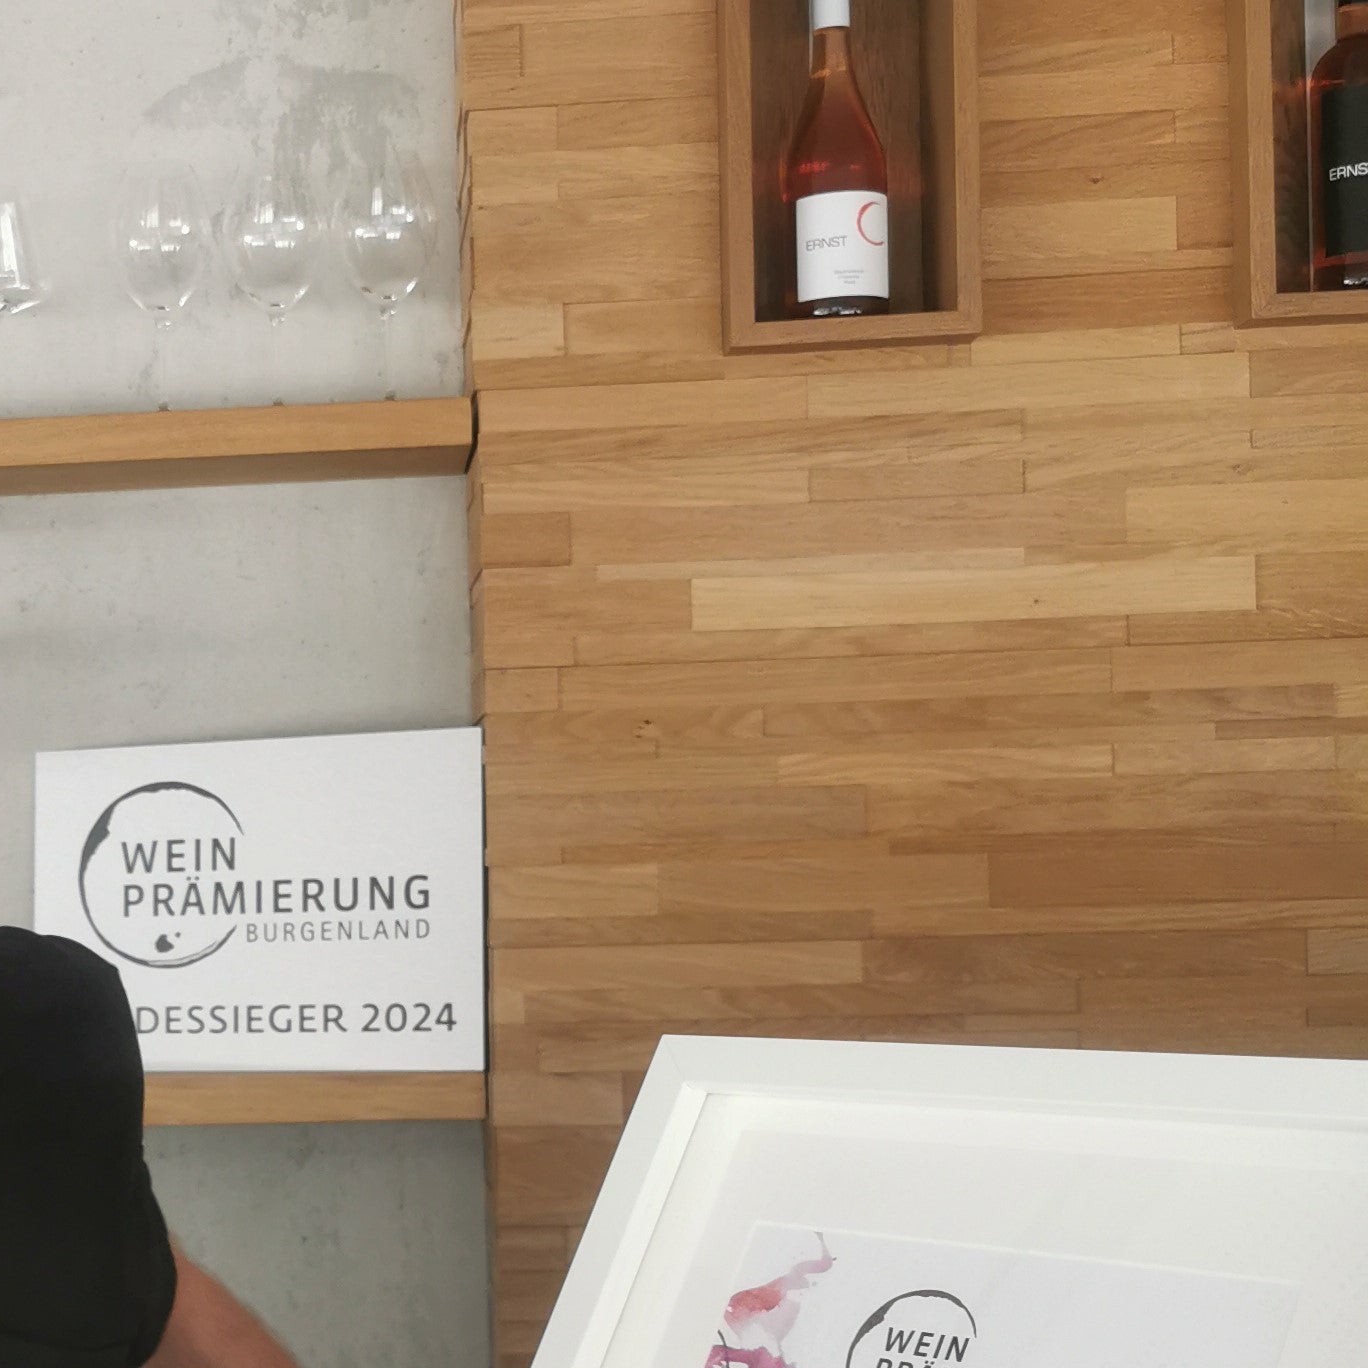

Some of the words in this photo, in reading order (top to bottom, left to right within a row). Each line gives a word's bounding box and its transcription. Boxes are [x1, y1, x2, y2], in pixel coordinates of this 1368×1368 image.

[1329, 161, 1368, 182] ERNS
[806, 235, 847, 252] ERNST
[121, 837, 237, 874] WEIN
[123, 874, 430, 918] PRÄMIERUNG
[246, 919, 431, 943] BURGENLAND
[136, 1004, 348, 1035] DESSIEGER
[361, 1002, 458, 1032] 2024
[885, 1327, 970, 1362] WEIN
